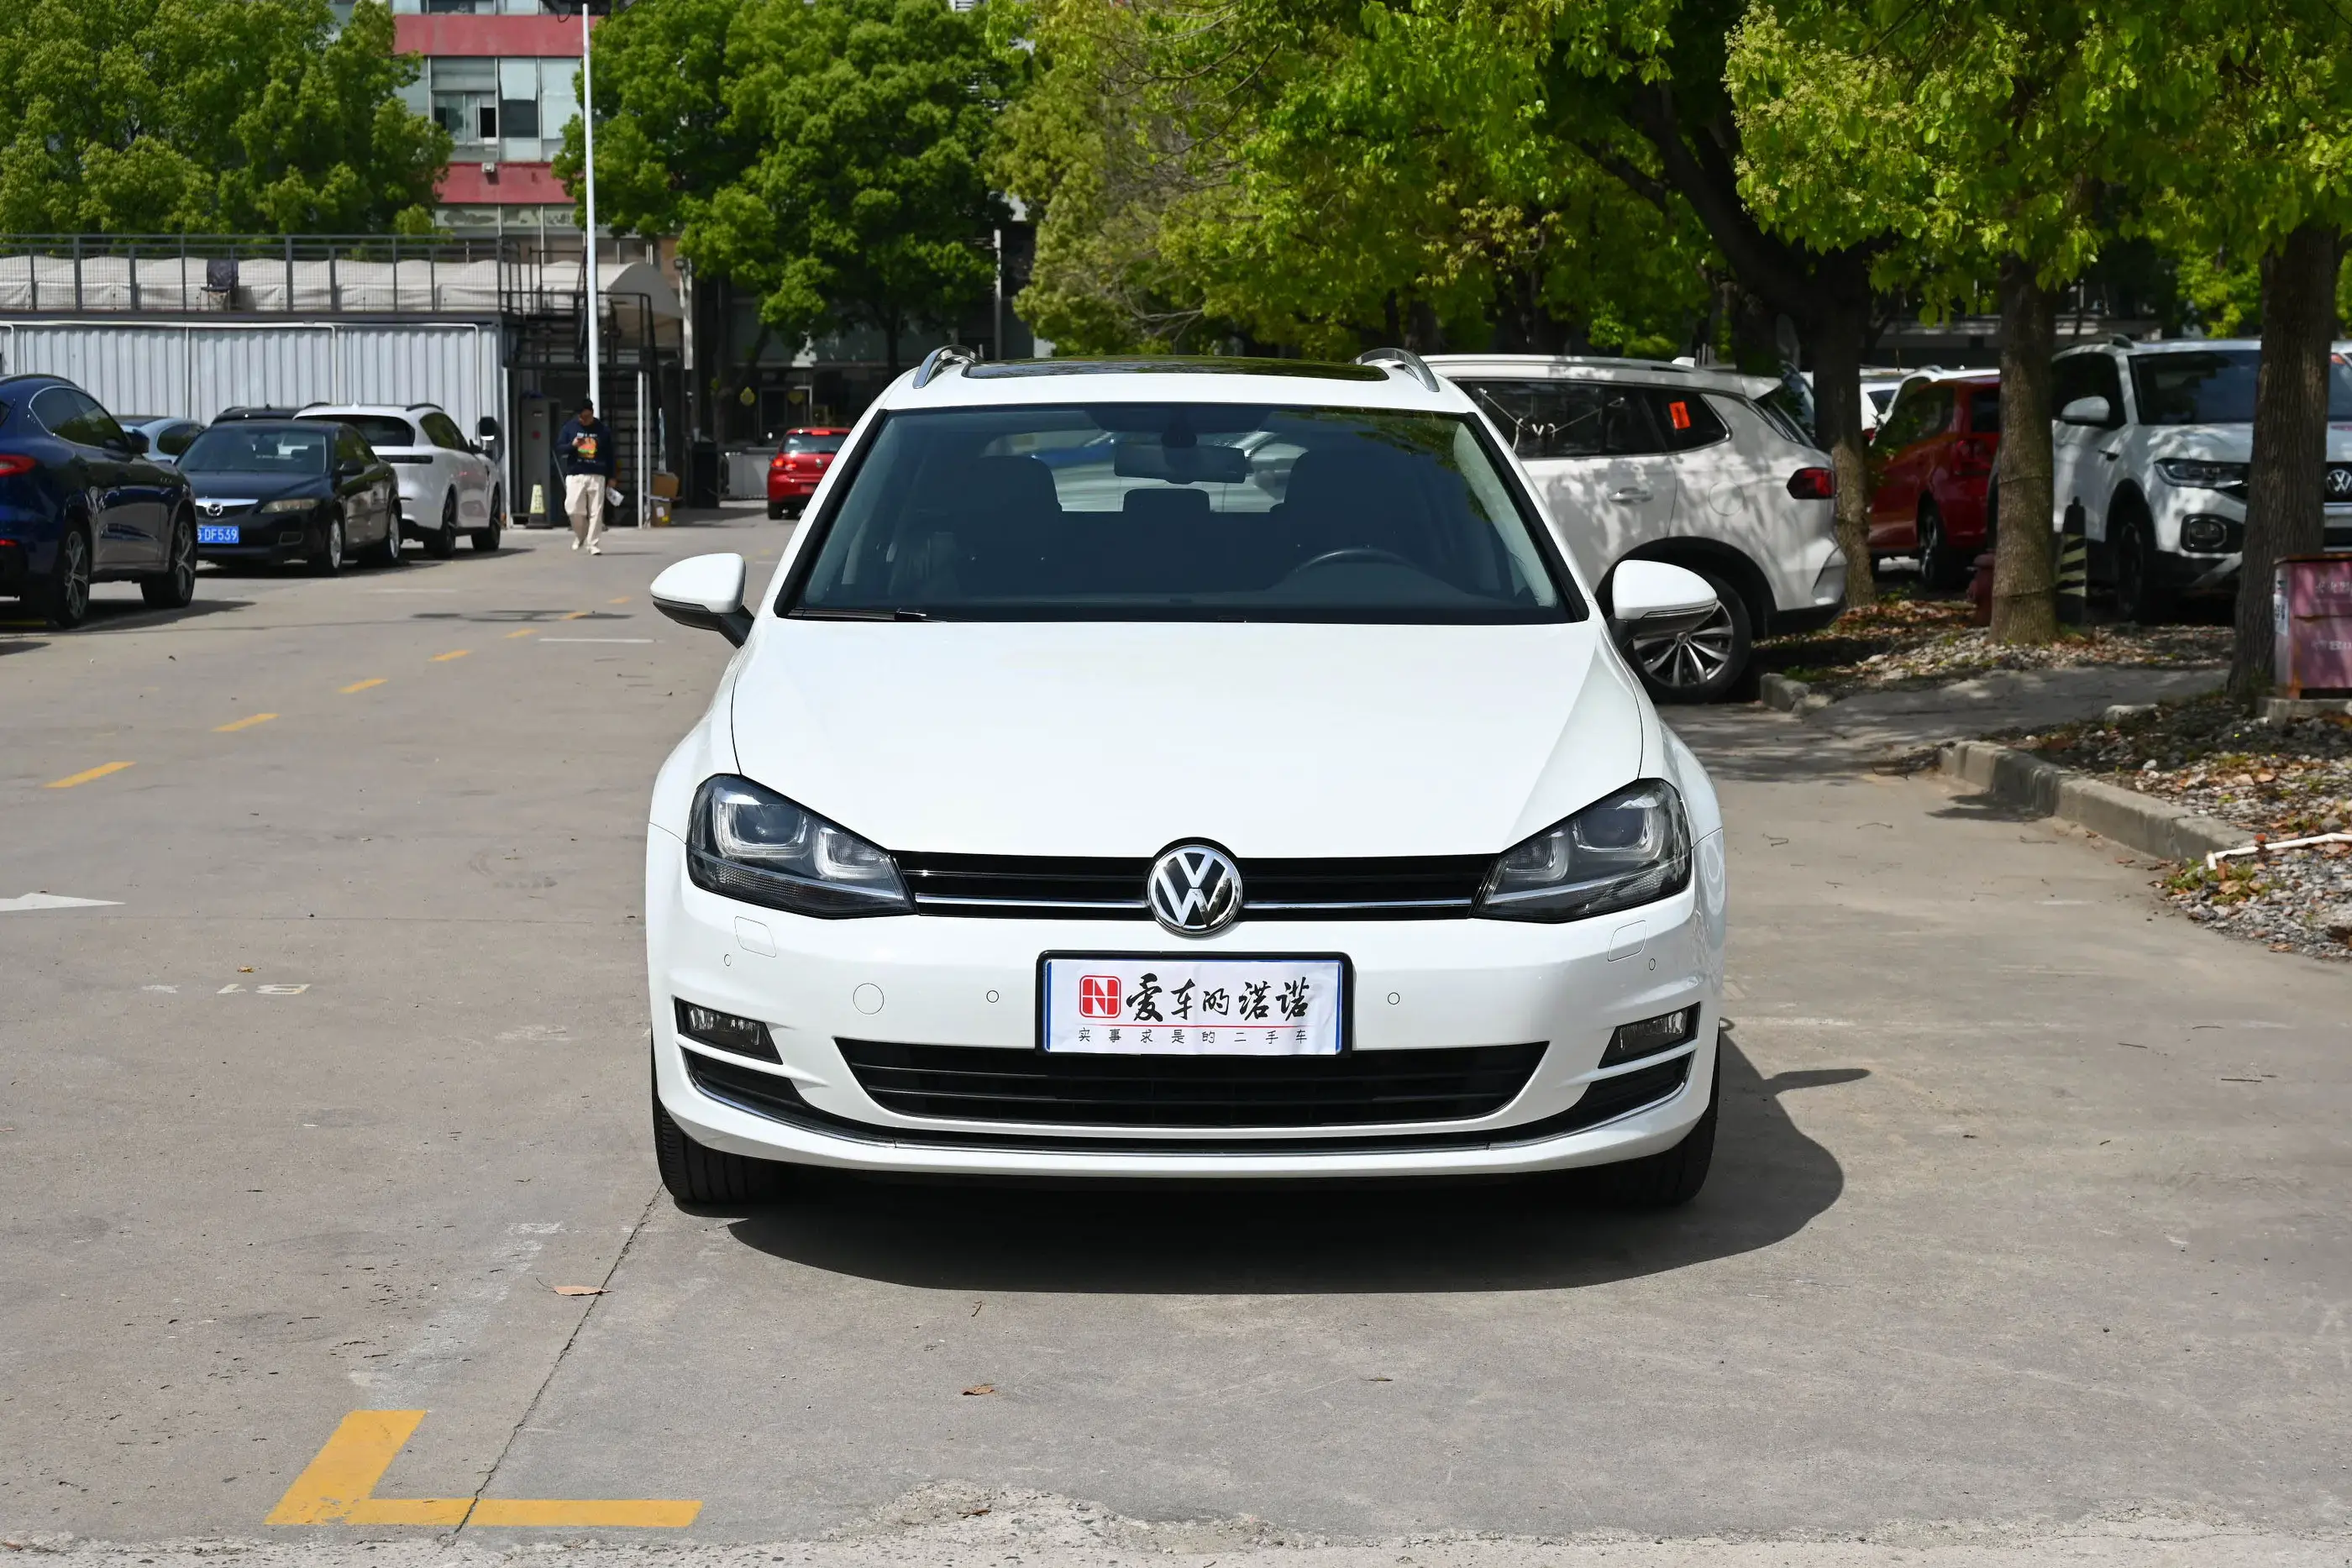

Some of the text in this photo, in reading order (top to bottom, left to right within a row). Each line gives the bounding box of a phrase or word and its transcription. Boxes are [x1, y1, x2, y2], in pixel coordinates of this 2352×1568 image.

[1079, 1027, 1308, 1044] 实事求是的二手车
